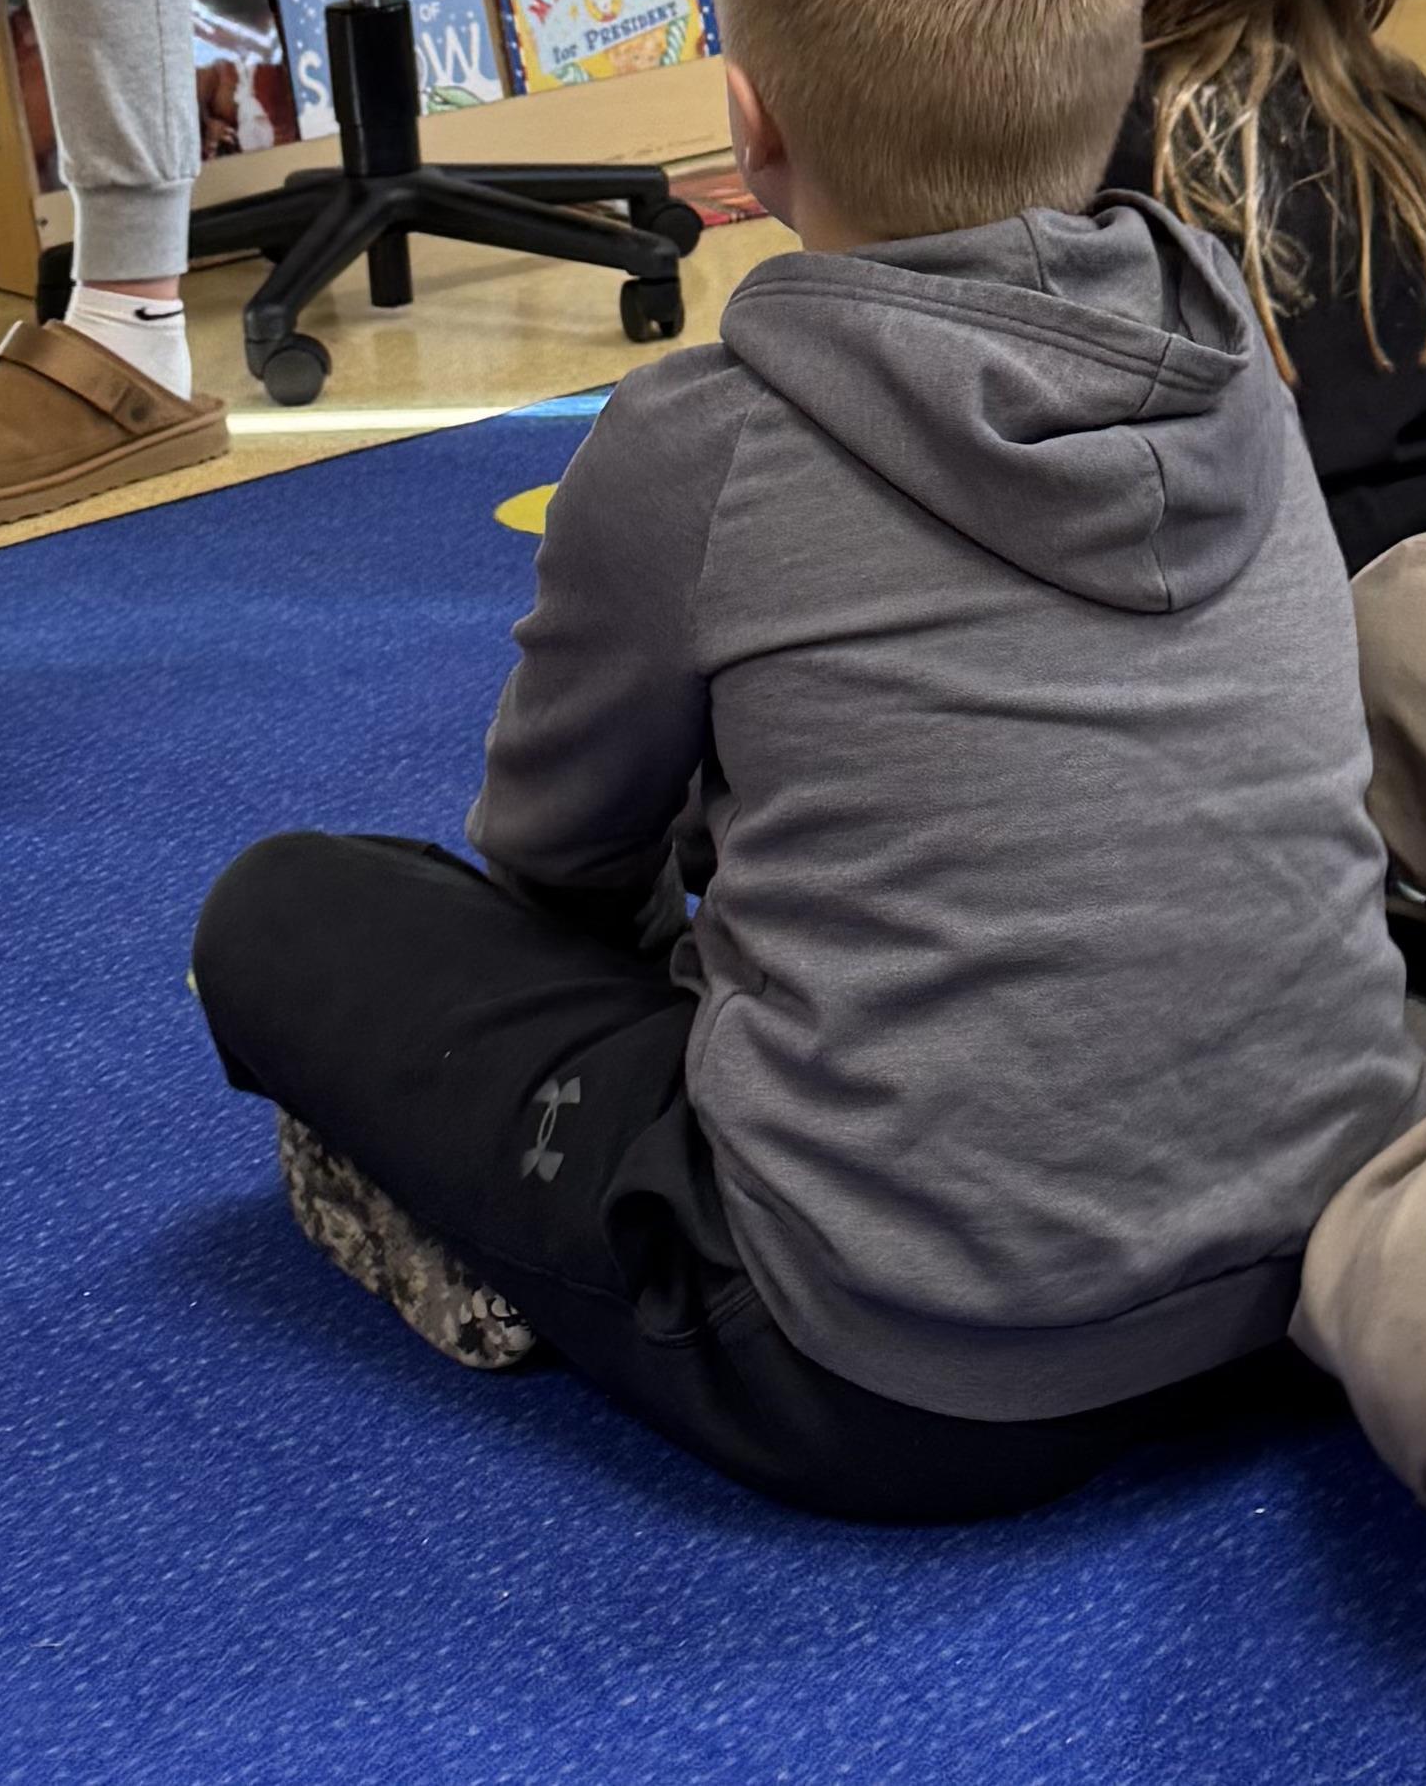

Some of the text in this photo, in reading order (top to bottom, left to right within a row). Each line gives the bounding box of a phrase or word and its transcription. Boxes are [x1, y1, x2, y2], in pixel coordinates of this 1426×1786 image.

[420, 2, 442, 23] OF
[553, 0, 678, 65] for PRESIDENT
